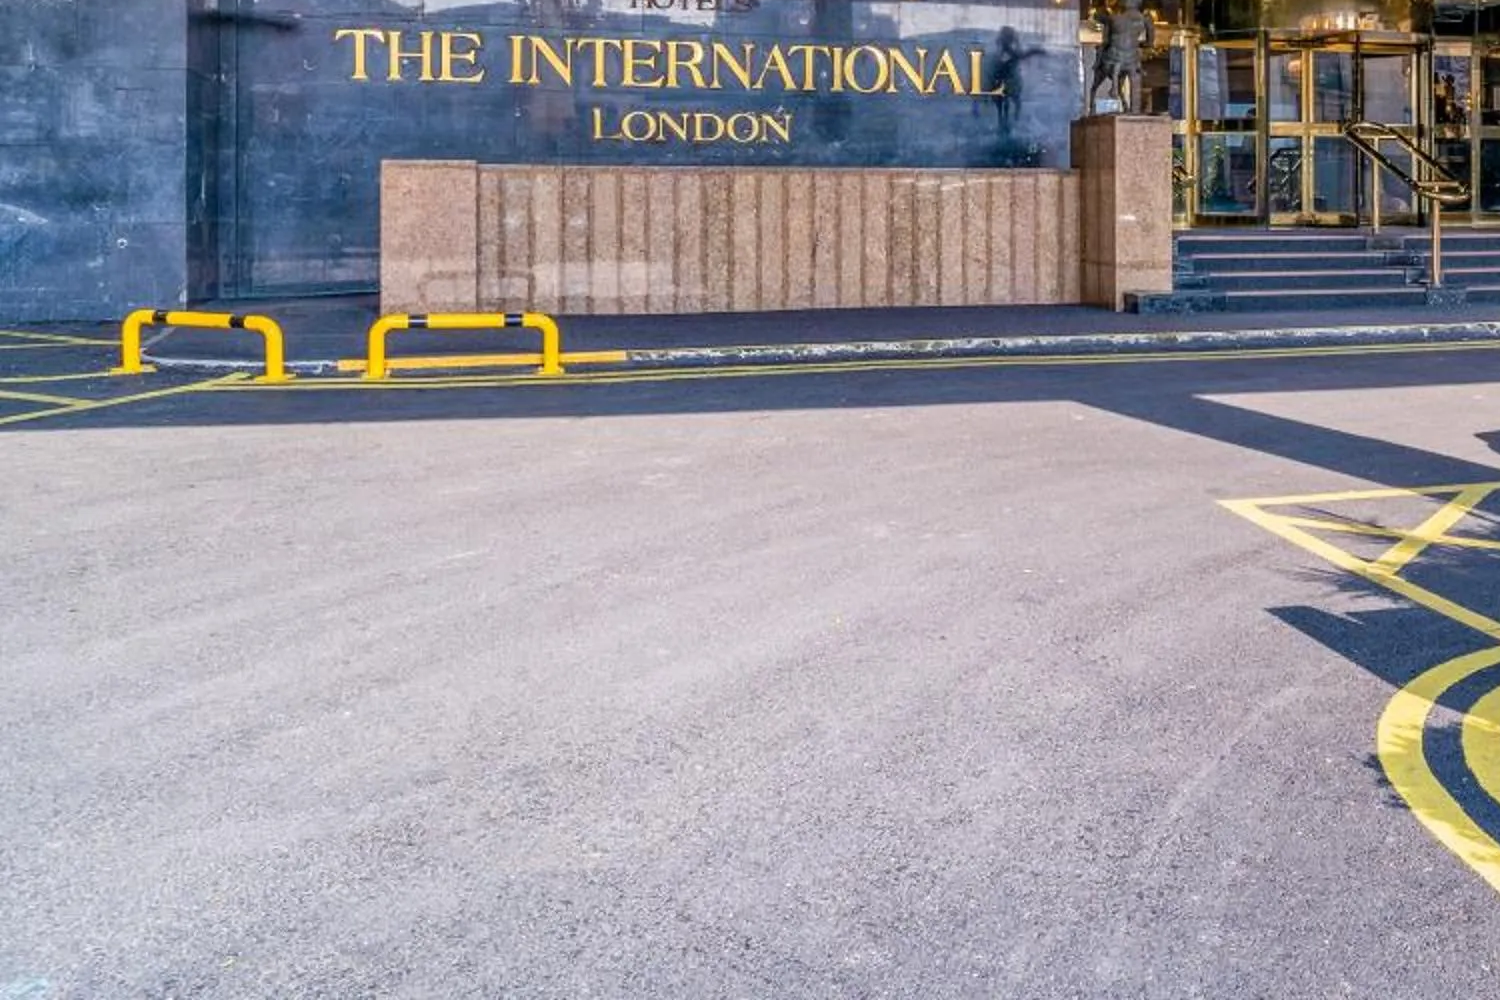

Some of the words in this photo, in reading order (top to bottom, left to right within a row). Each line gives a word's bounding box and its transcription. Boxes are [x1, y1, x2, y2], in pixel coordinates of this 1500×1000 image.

[335, 29, 484, 83] THE
[508, 35, 1004, 96] INTERNATIONAL
[592, 108, 791, 143] LONDON
